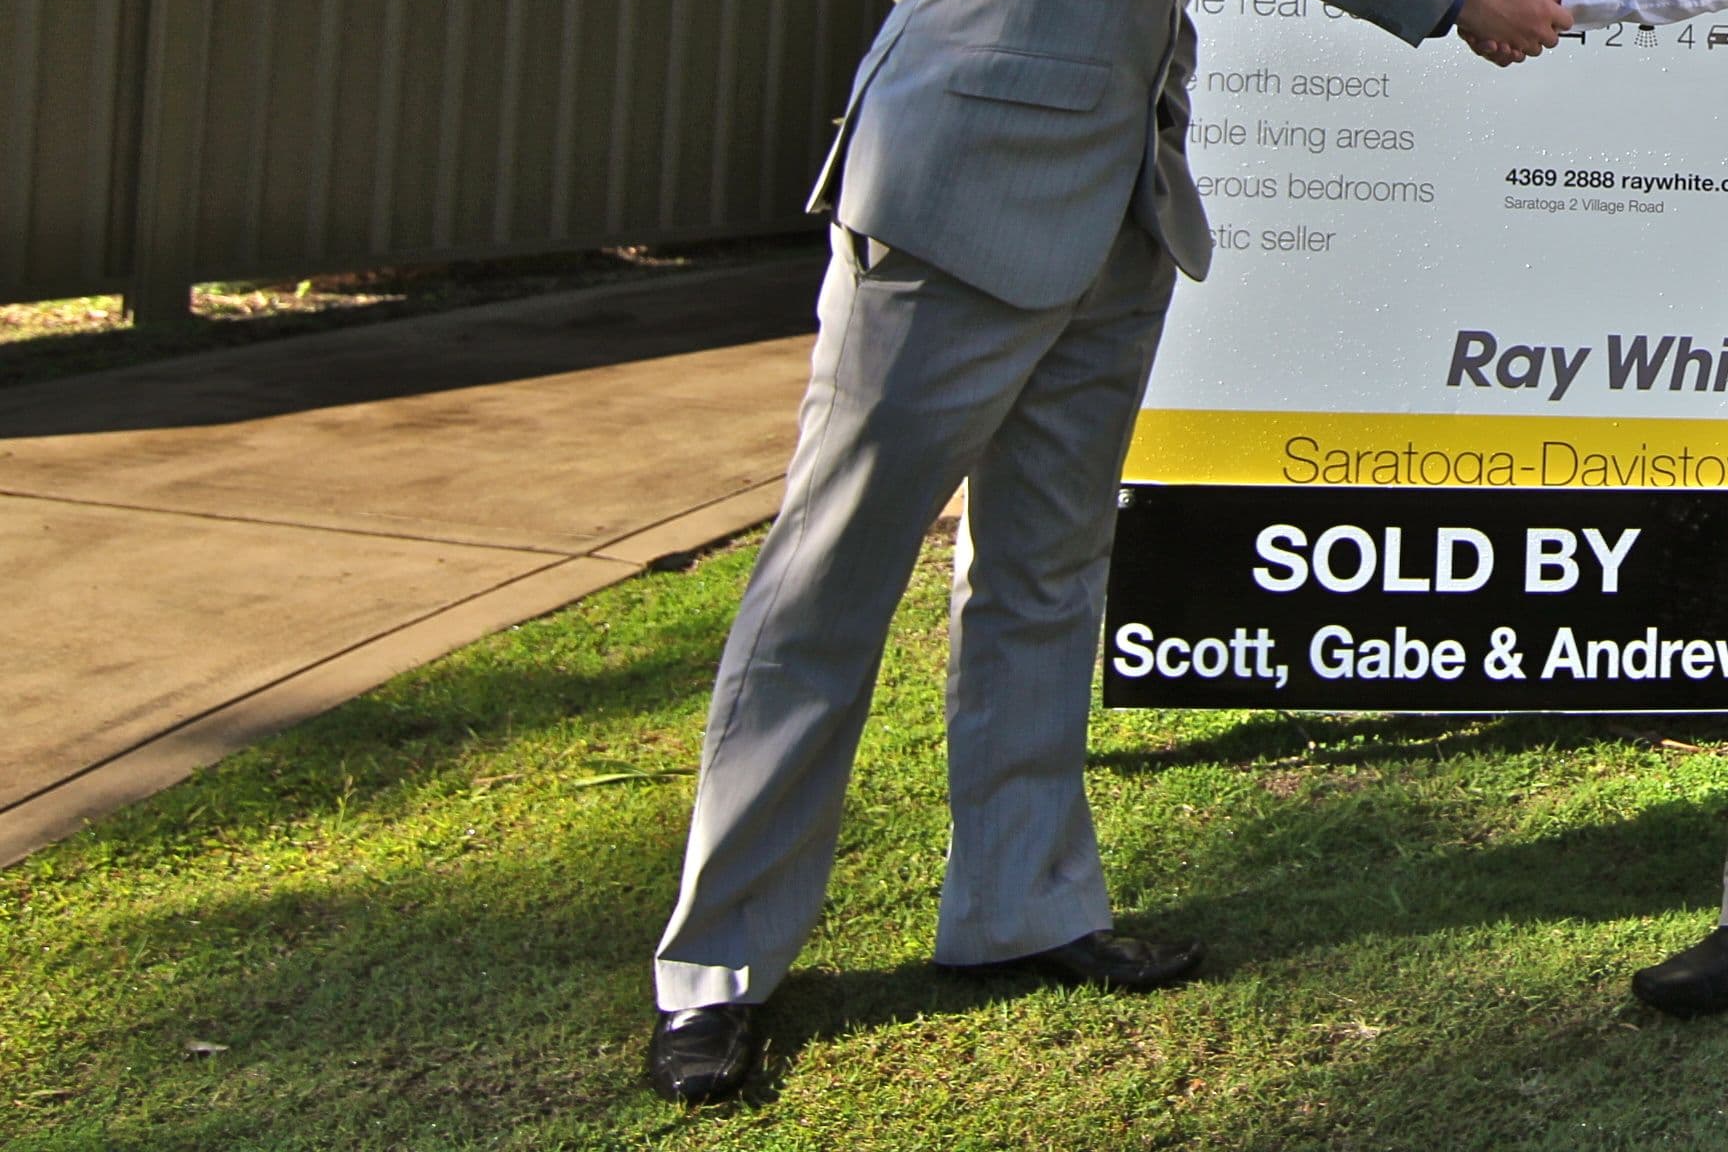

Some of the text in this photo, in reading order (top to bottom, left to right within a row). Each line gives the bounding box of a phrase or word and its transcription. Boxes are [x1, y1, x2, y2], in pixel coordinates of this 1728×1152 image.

[1606, 24, 1623, 47] 2
[1677, 24, 1696, 49] 4
[1208, 68, 1281, 94] north
[1291, 73, 1389, 101] aspect
[1188, 118, 1415, 154] tiple living areas
[1197, 173, 1435, 202] erous bedrooms
[1505, 168, 1557, 186] 4369
[1563, 170, 1615, 188] 2888
[1504, 196, 1664, 214] Saratoga 2 Village Road
[1261, 225, 1336, 251] seller
[1446, 330, 1592, 401] Ray
[1252, 524, 1642, 593] SOLD BY
[1113, 622, 1289, 689] Scott,
[1309, 625, 1466, 680] Gabe
[1483, 626, 1526, 680] &
